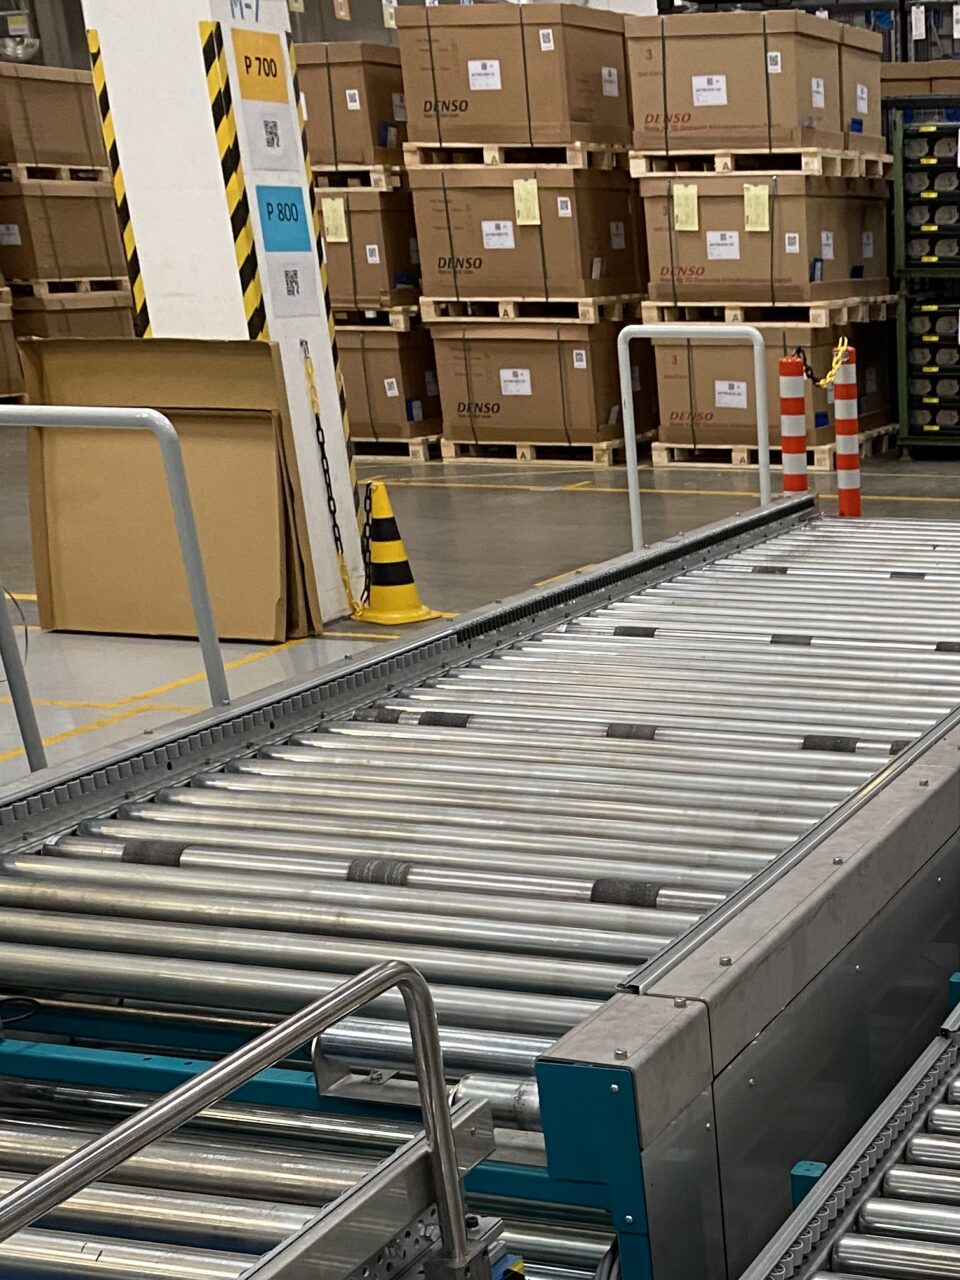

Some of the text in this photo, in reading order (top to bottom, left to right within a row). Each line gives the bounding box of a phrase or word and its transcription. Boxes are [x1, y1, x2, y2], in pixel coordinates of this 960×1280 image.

[244, 55, 277, 78] P 700
[645, 112, 691, 124] DENSO
[266, 201, 299, 222] P 800
[437, 256, 483, 270] DENSO
[660, 266, 705, 276] DNSO
[457, 402, 501, 414] DENSO
